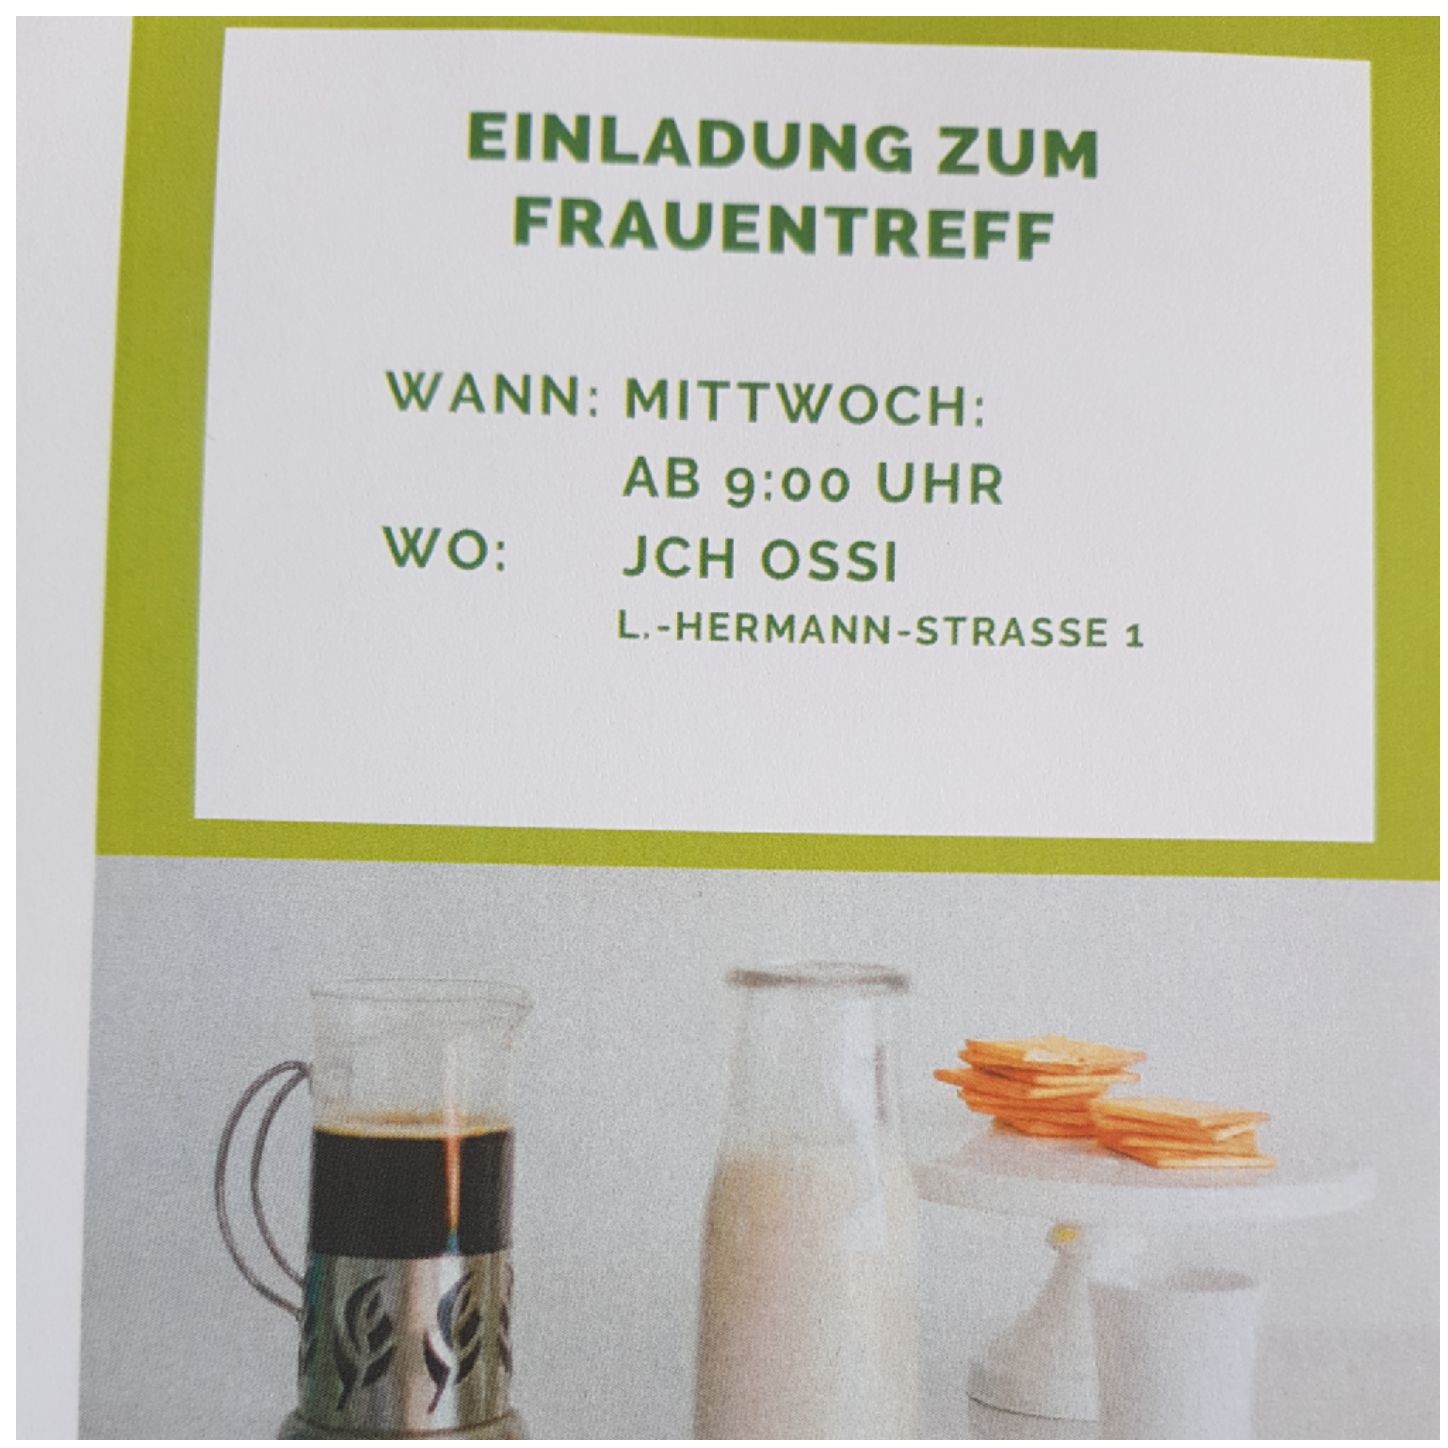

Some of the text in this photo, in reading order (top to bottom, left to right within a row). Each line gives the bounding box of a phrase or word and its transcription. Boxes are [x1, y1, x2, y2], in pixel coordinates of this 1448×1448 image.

[468, 111, 1100, 179] EINLADUNG ZUM
[513, 196, 1056, 261] FRAUENTREFF
[385, 370, 985, 428] WANN: MITTWOCH:
[622, 456, 1004, 509] AB 9:00 UHR
[382, 526, 898, 583] WO: JCH OSSI
[617, 609, 1146, 650] L.-HERMANN-STRASSE 1
